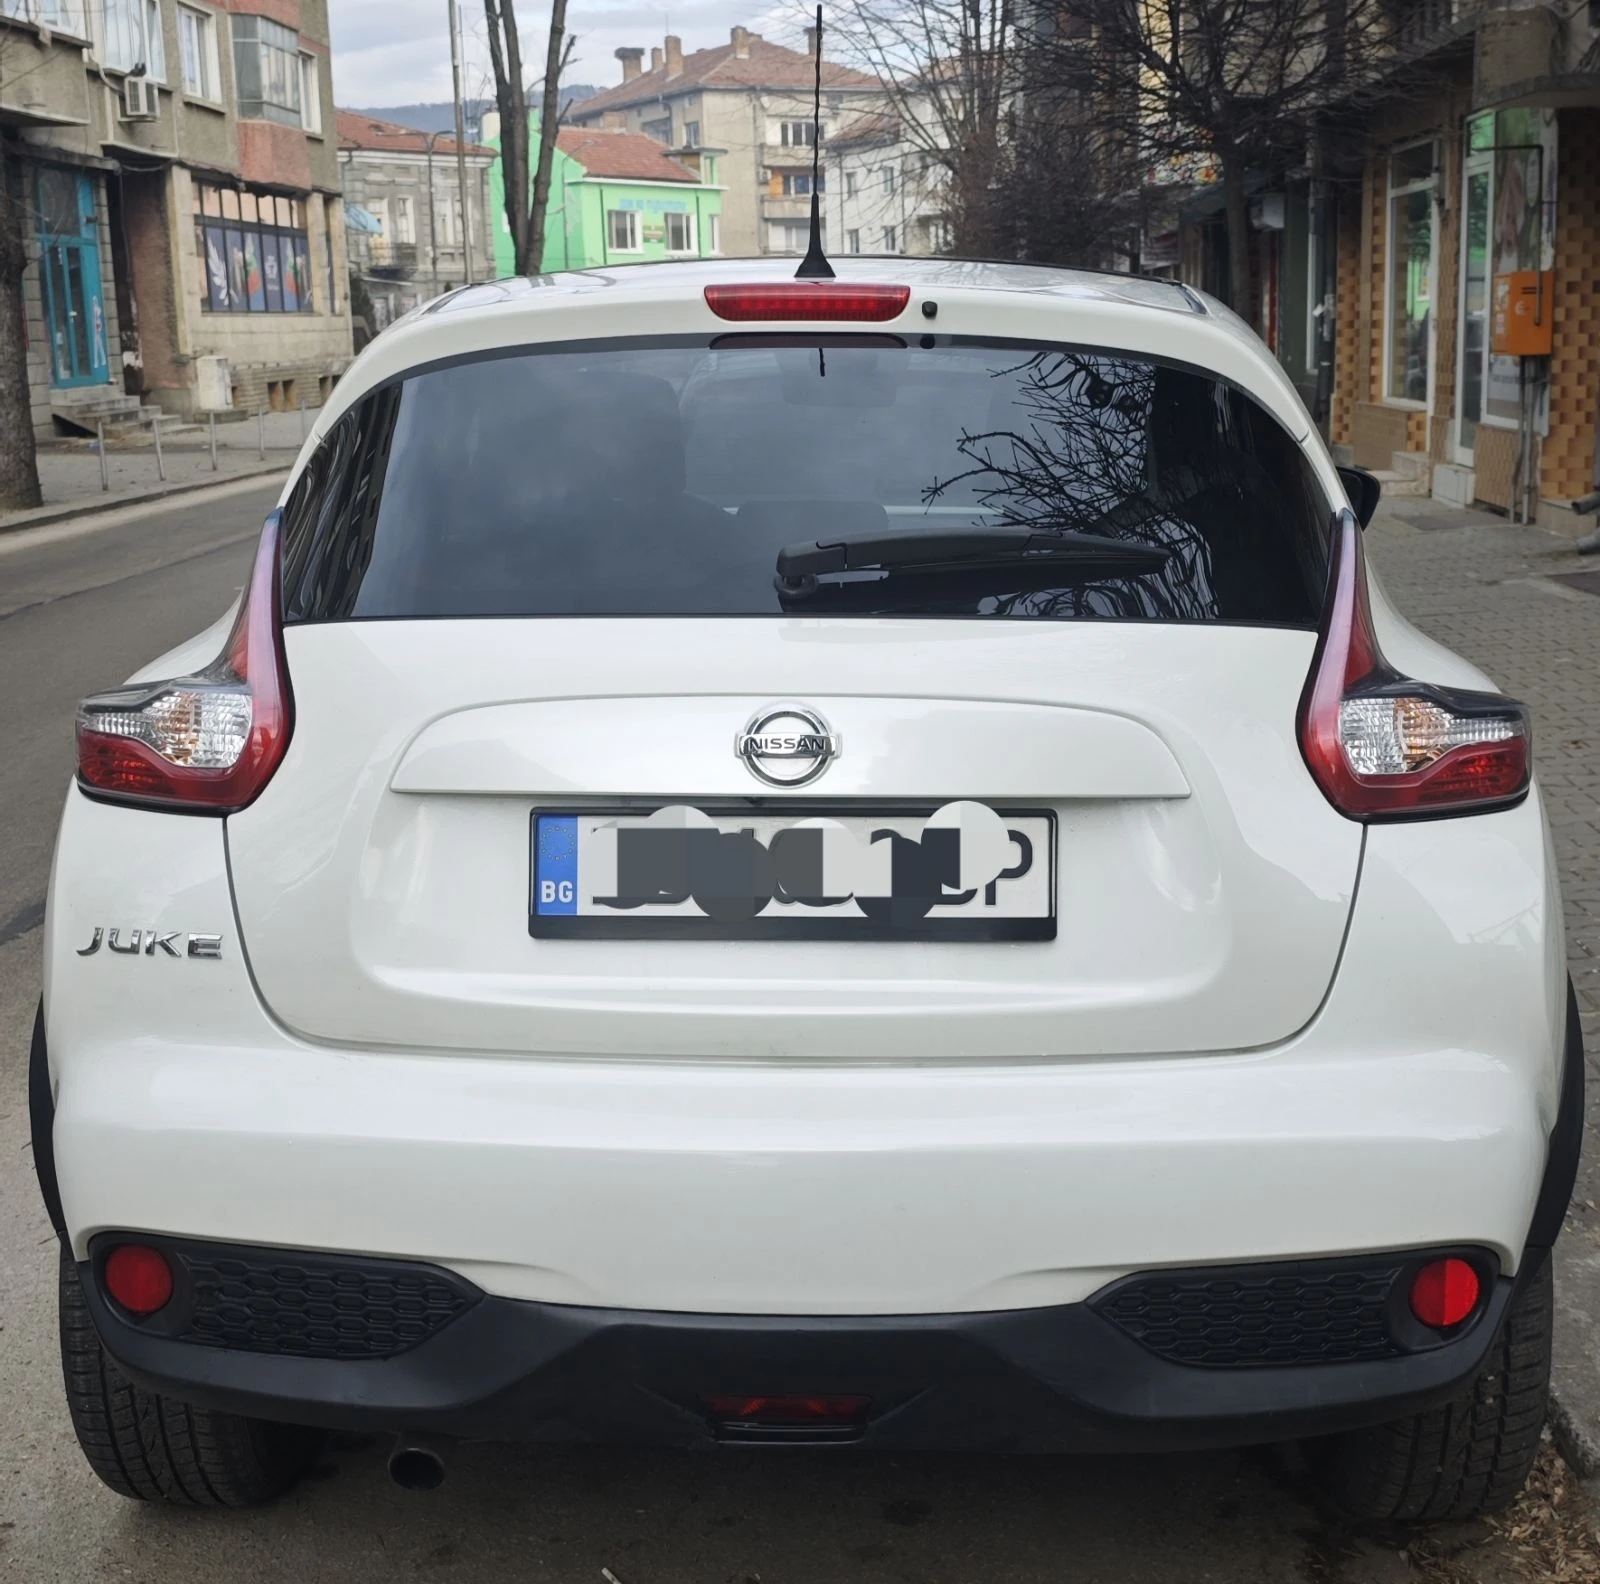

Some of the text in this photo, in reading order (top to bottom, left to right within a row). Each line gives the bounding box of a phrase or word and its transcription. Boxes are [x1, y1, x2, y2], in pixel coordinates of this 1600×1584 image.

[749, 738, 825, 750] NISSAN
[541, 880, 573, 903] BG
[76, 926, 224, 960] JUKE
